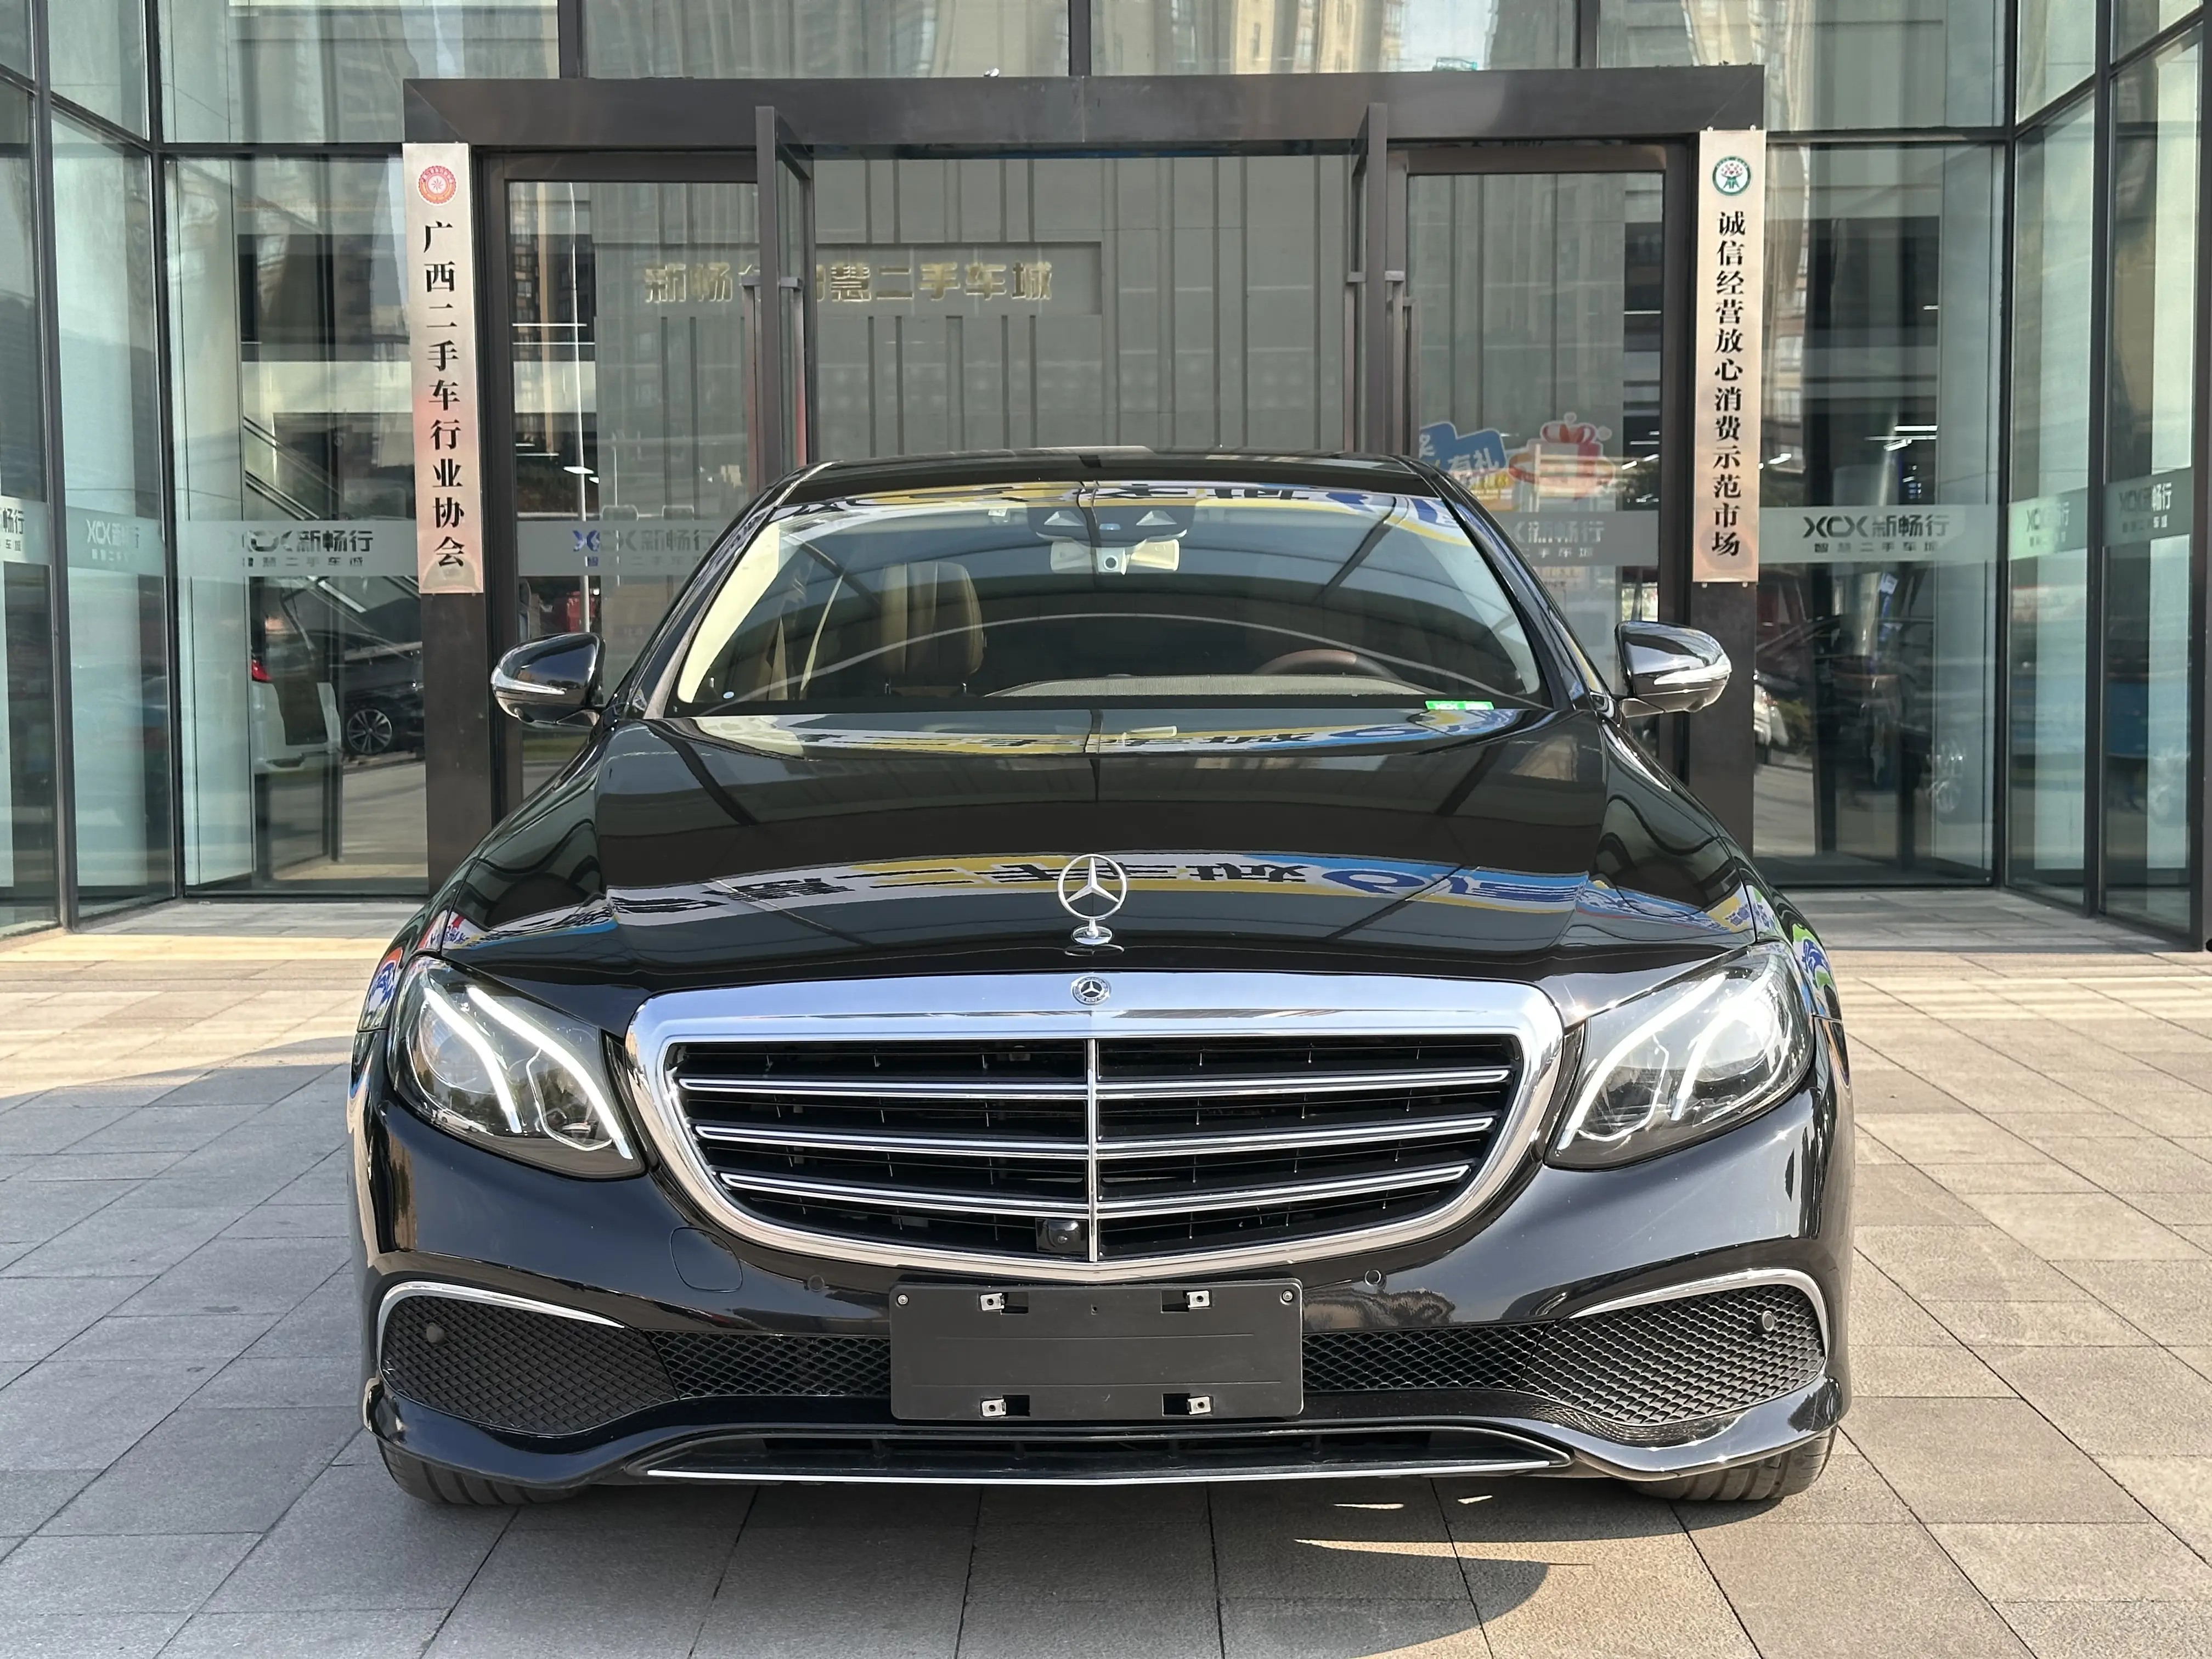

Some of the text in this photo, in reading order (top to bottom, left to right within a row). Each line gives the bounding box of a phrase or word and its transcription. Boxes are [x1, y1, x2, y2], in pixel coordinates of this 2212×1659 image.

[645, 261, 1052, 303] 新畅慧二手车城
[423, 221, 465, 567] 广西二手车行业协会
[1712, 211, 1746, 556] 诚信经营放心消费示范市场
[0, 507, 25, 534] 畅行
[1872, 514, 1950, 538] 新畅行
[296, 530, 374, 552] 新畅行
